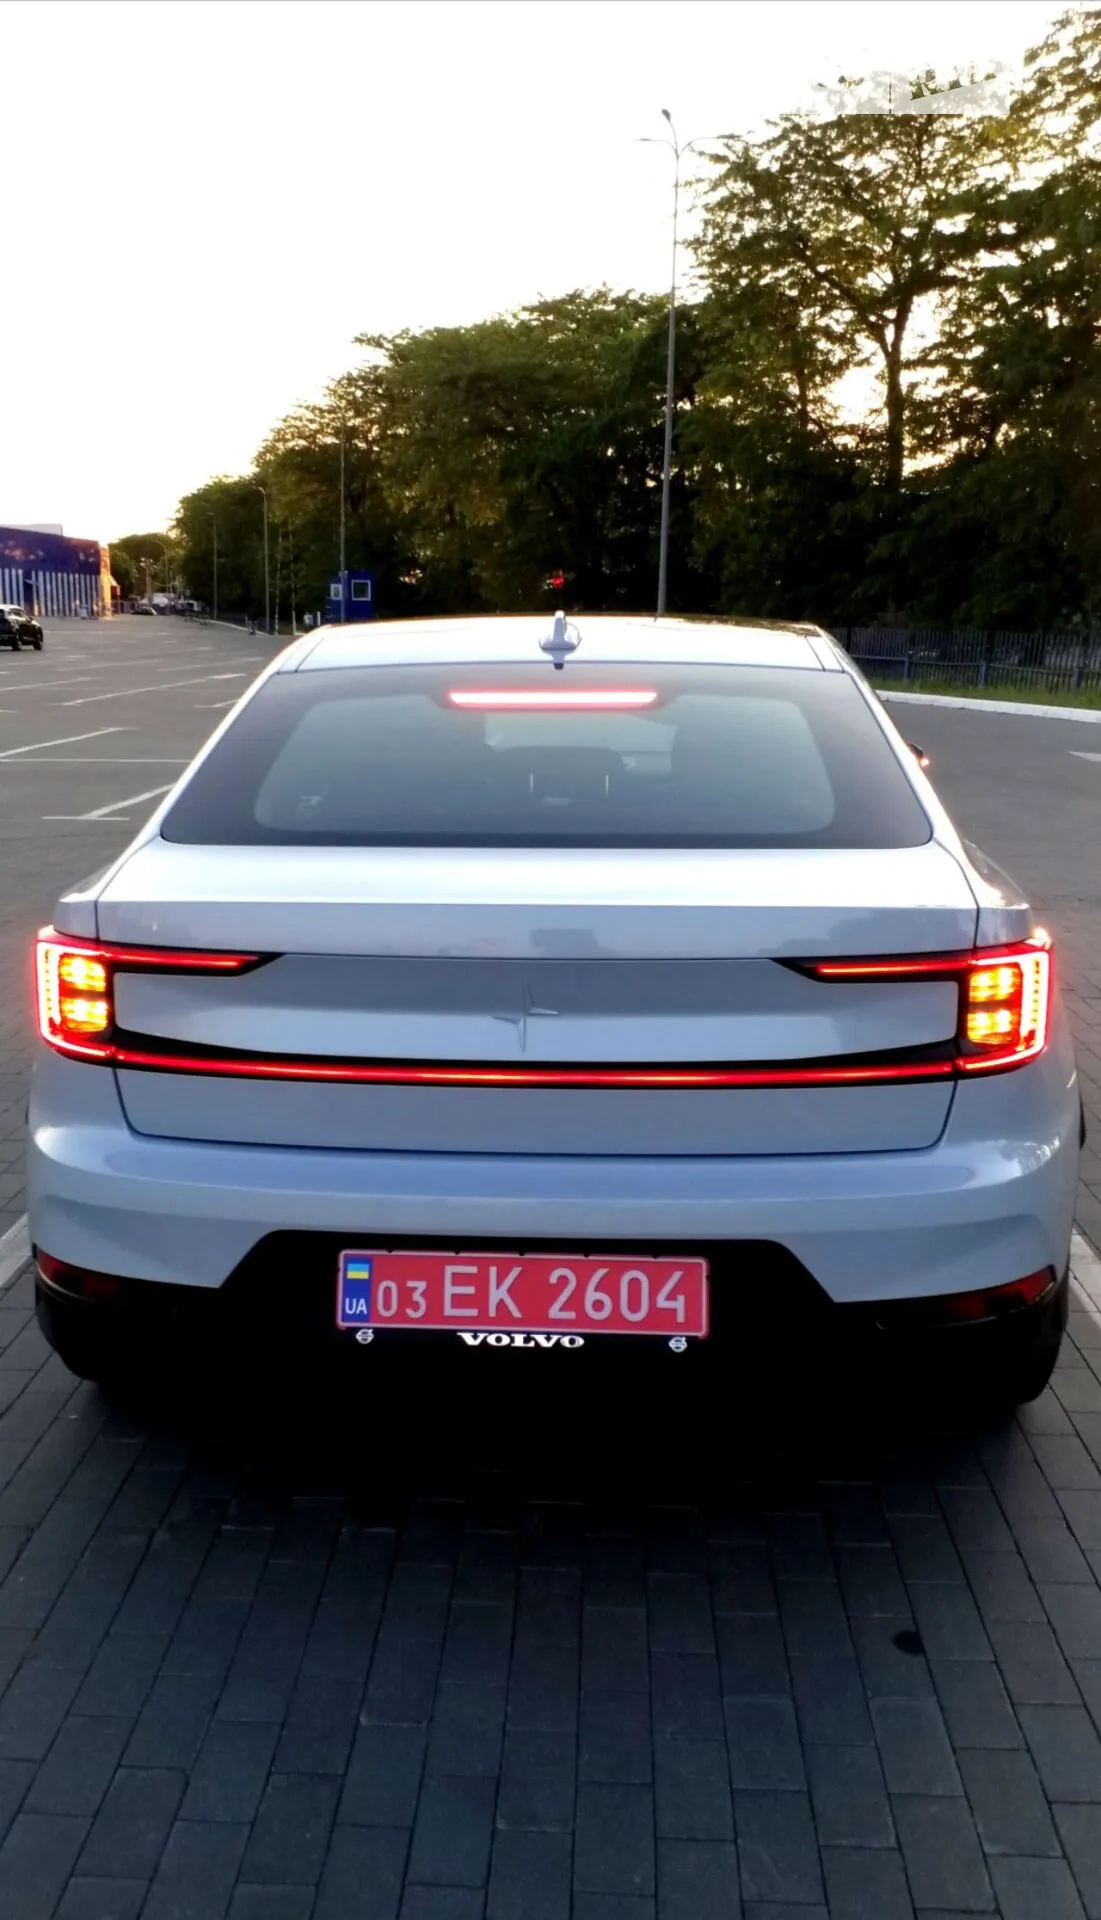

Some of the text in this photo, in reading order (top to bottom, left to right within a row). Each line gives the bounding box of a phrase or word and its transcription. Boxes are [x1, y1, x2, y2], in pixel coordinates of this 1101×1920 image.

[377, 1265, 685, 1323] 03 EK 2604
[345, 1299, 367, 1315] UA
[457, 1332, 585, 1348] VOLVO
